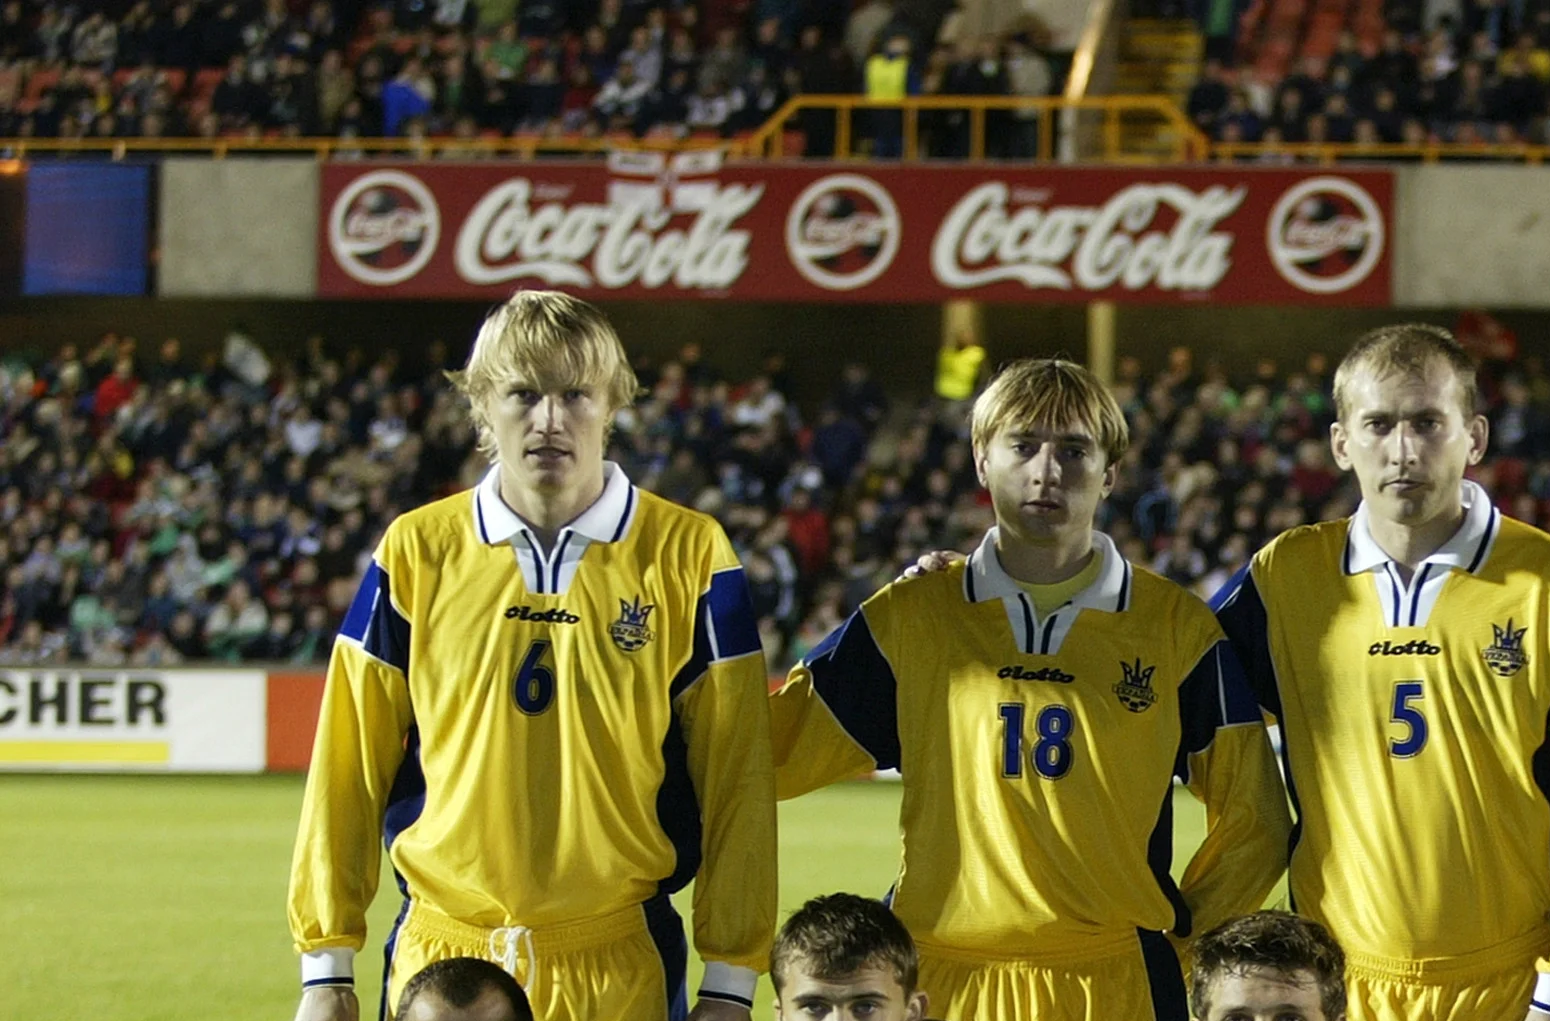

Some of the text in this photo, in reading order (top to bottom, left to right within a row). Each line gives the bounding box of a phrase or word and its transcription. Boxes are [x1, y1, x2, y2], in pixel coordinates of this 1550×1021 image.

[931, 181, 1248, 291] Coca-Cola
[513, 639, 556, 716] 6
[1381, 640, 1441, 656] lotto
[998, 702, 1075, 780] 18
[1389, 680, 1429, 760] 5
